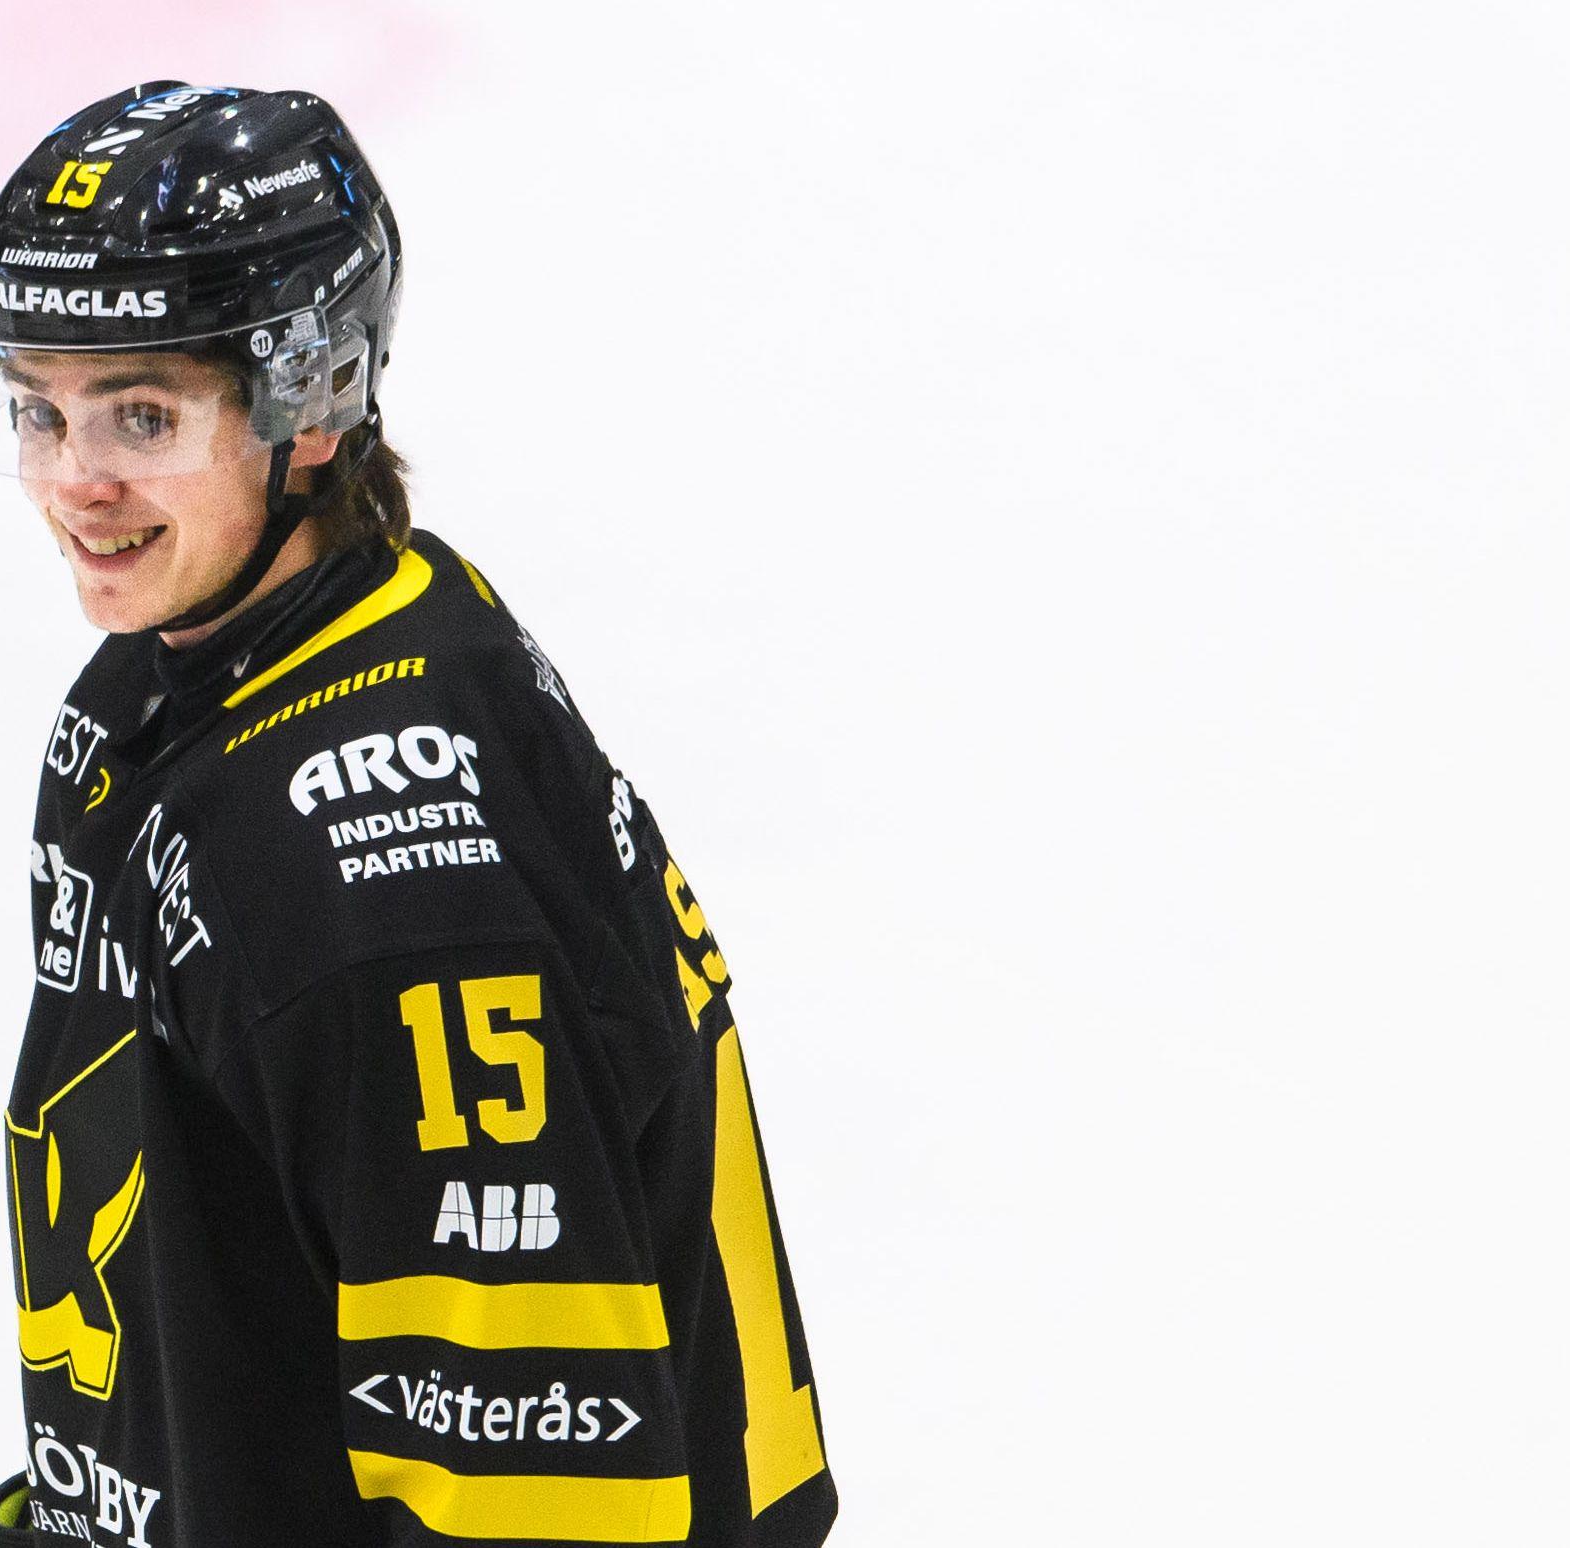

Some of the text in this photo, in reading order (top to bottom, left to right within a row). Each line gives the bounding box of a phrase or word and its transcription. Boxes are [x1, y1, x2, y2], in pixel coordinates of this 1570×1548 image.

[46, 160, 114, 209] 15
[243, 159, 322, 200] Newsafe
[0, 247, 98, 269] WARRIOR
[224, 656, 427, 755] WARRIOR
[288, 725, 481, 817] AROS
[338, 837, 502, 884] PARTNER
[399, 973, 547, 1152] 15
[433, 1180, 561, 1253] ABB
